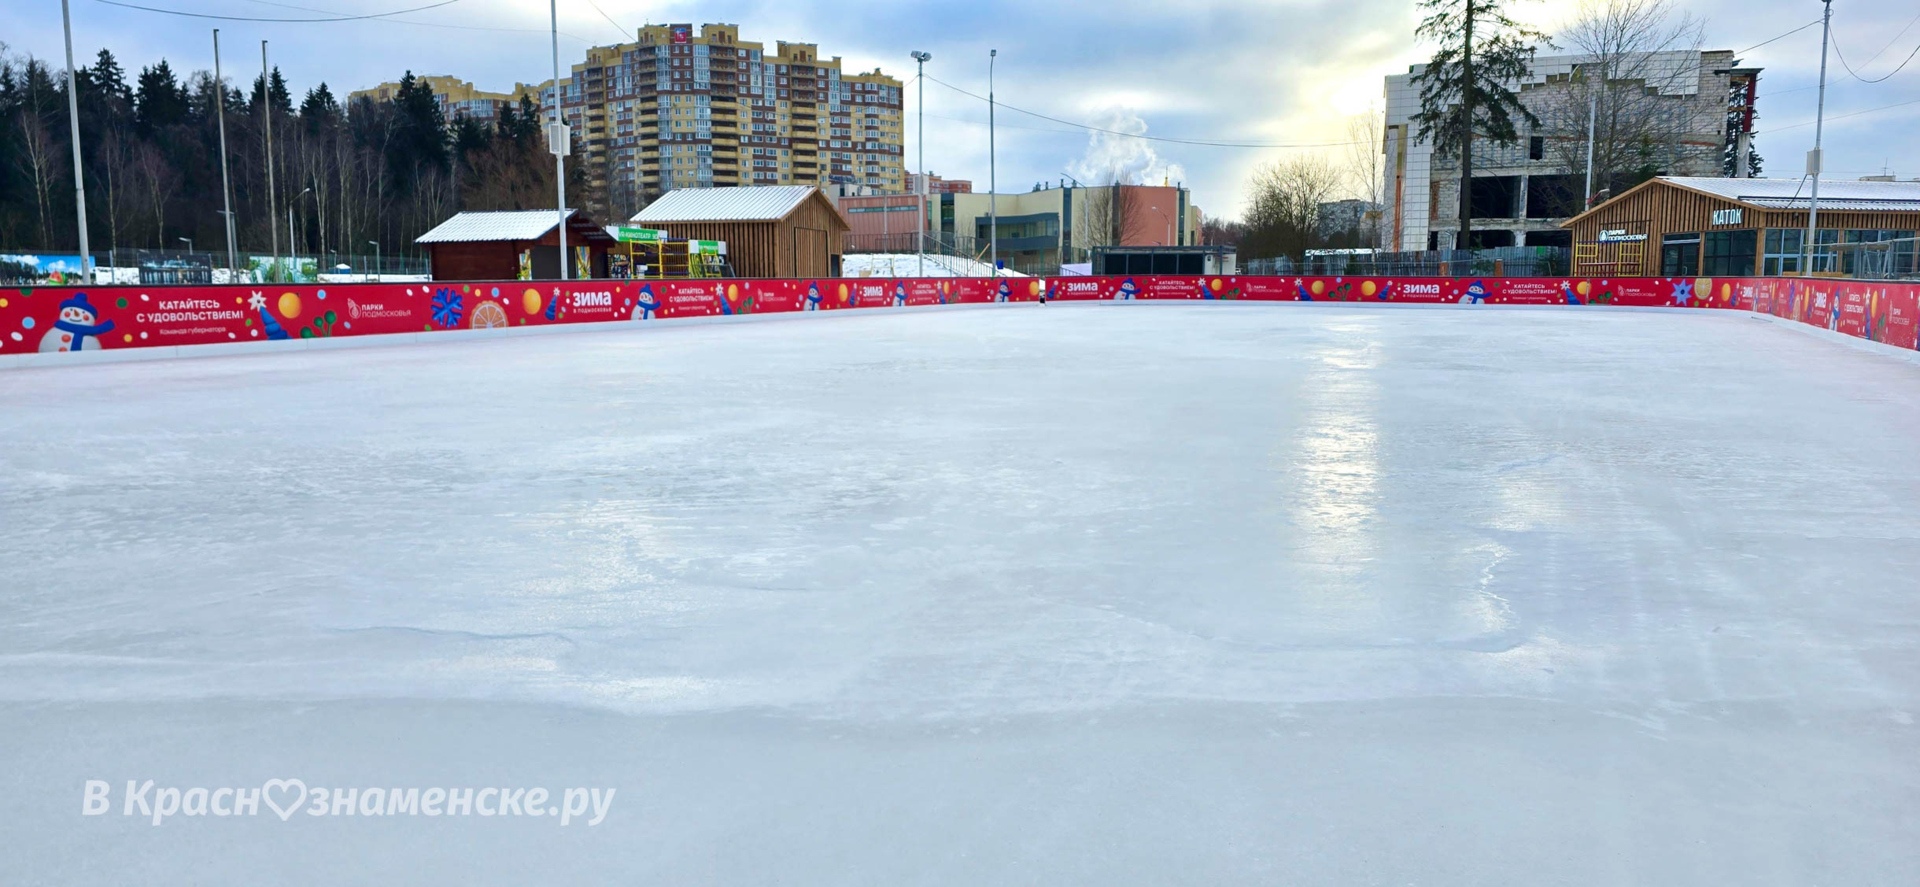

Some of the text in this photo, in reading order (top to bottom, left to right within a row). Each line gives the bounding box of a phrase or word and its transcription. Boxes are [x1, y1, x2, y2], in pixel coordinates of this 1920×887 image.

[1712, 208, 1742, 225] КАТОК
[159, 298, 220, 310] КАТАЙТЕСЬ
[136, 310, 244, 323] С УДОВОЛЬСТВИЕМ!
[361, 310, 411, 318] ПОДМОСКОВЬЯ
[188, 326, 226, 335] губернатора
